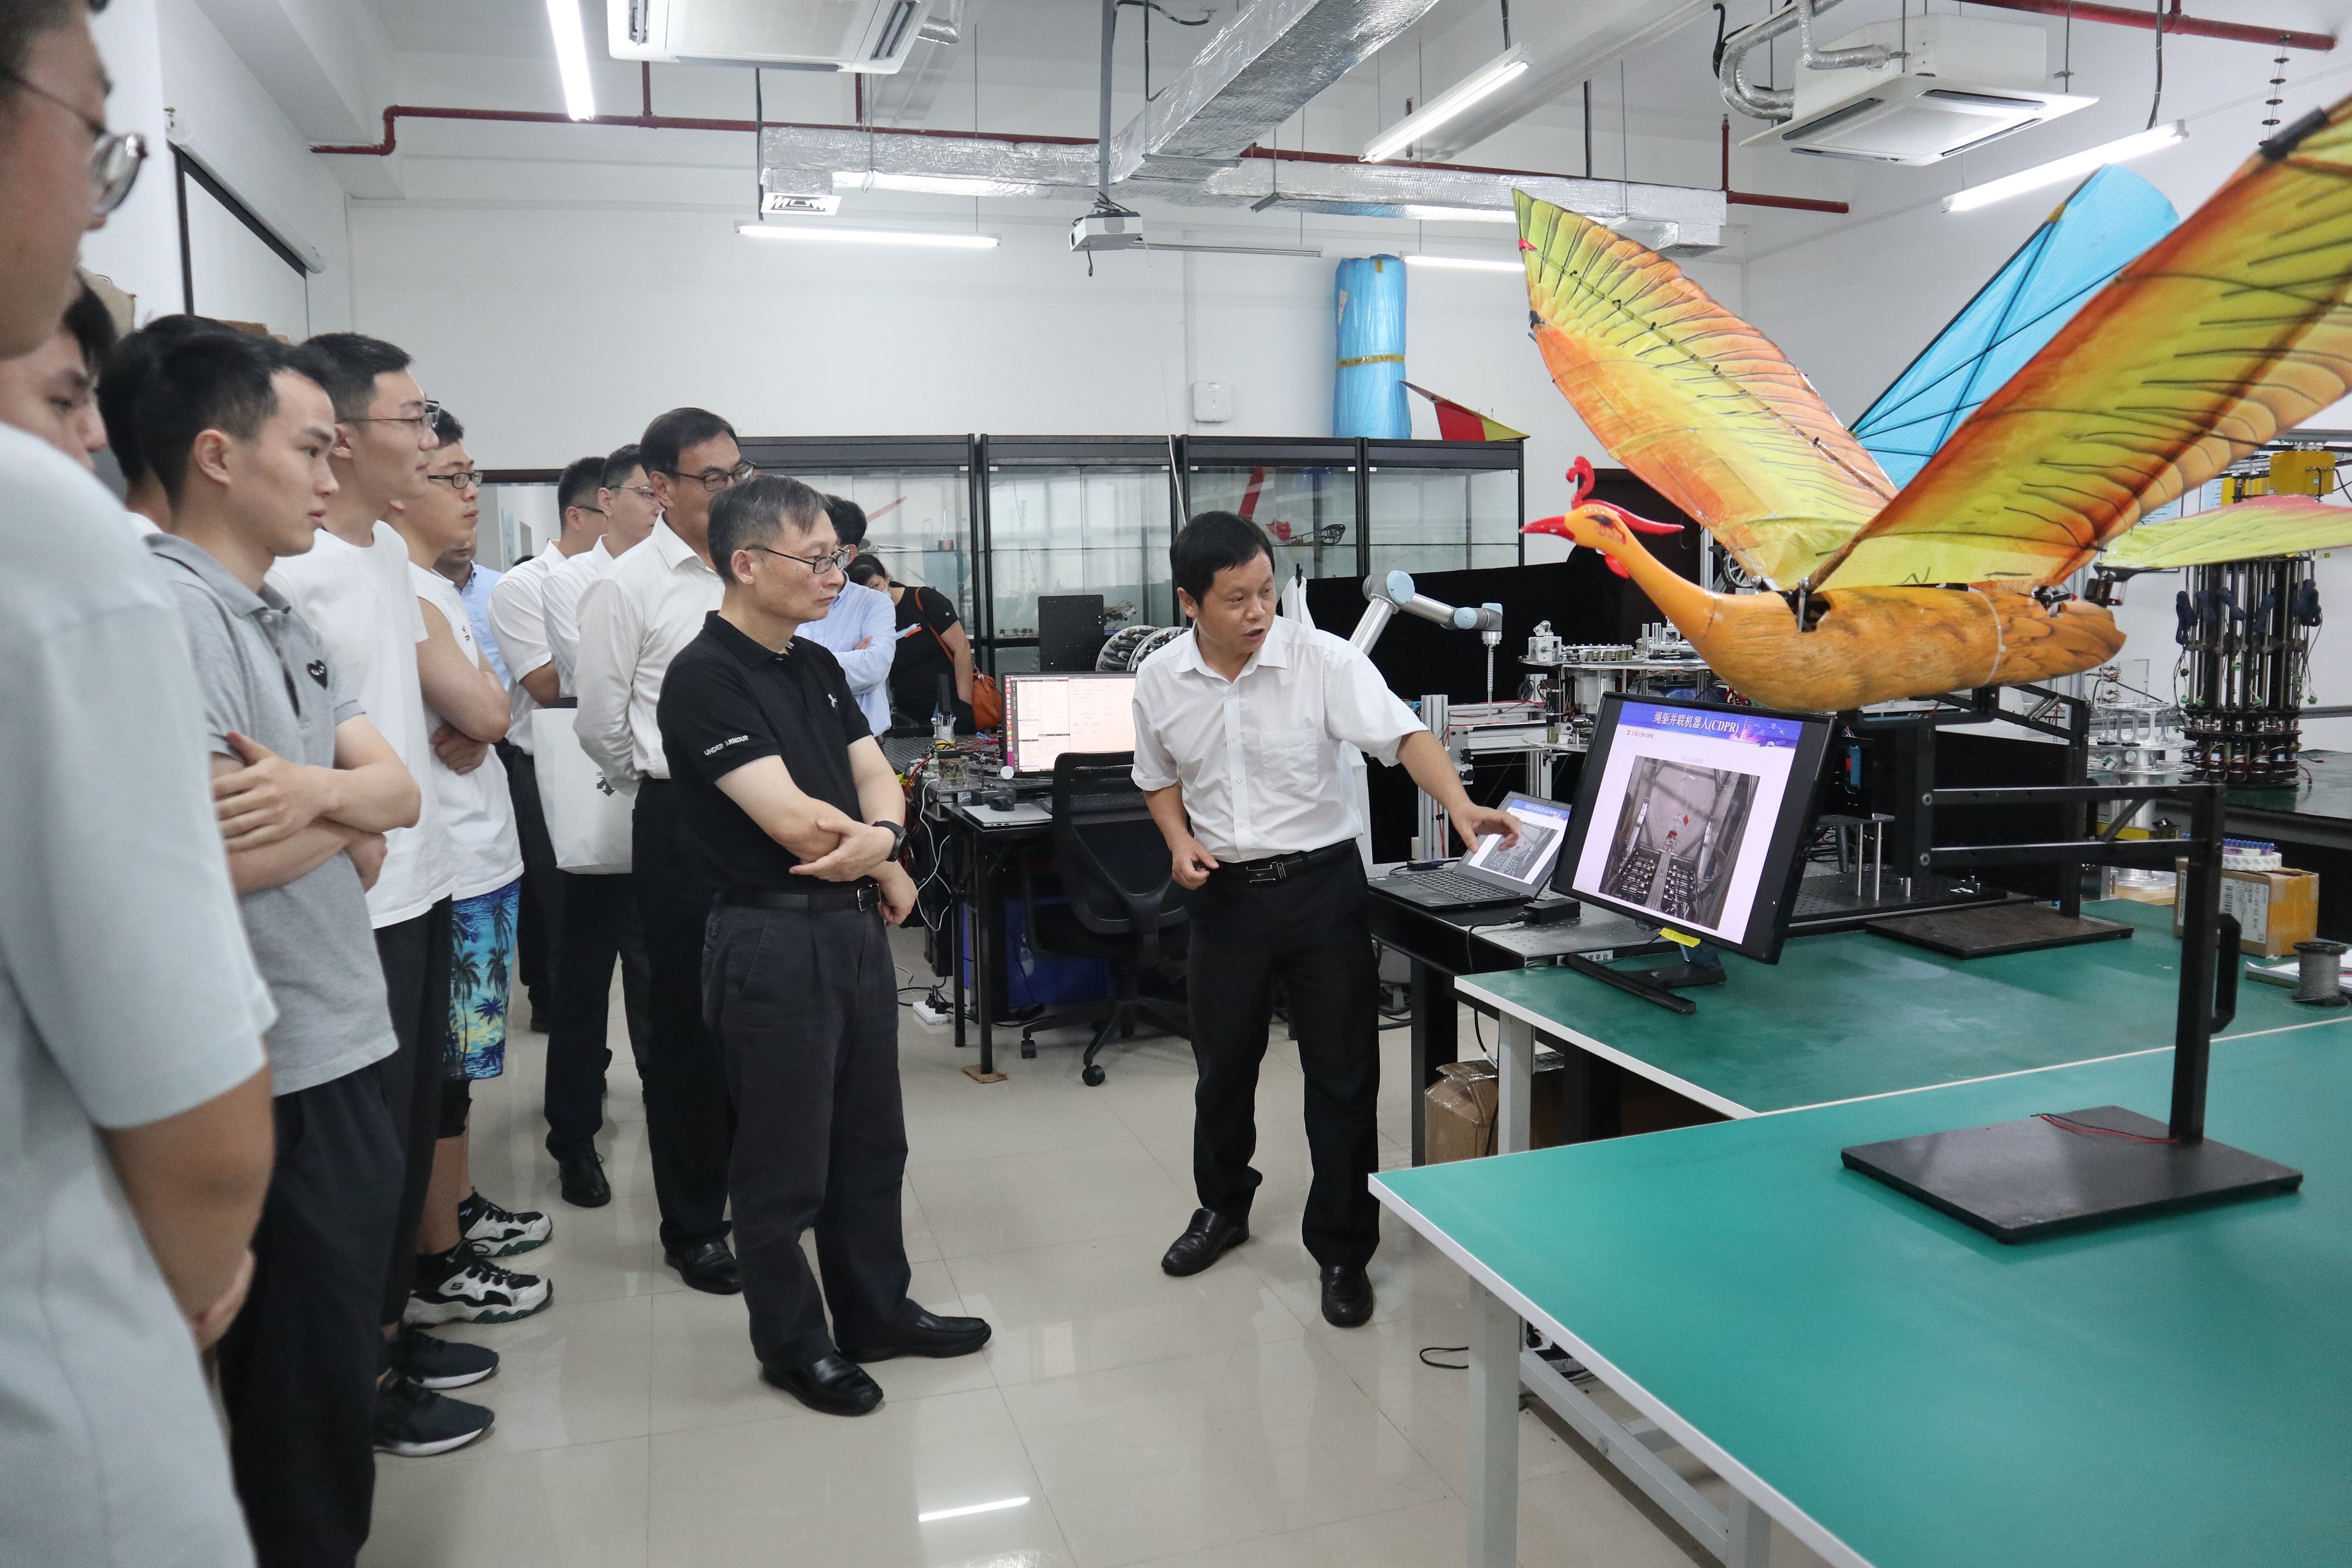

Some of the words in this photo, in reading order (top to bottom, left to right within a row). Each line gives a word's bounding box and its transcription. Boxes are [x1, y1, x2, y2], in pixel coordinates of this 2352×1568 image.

[1653, 711, 1739, 736] 绳驱并联机器人(CDPR)
[704, 743, 725, 755] UNDER
[724, 735, 749, 747] ARMOUR
